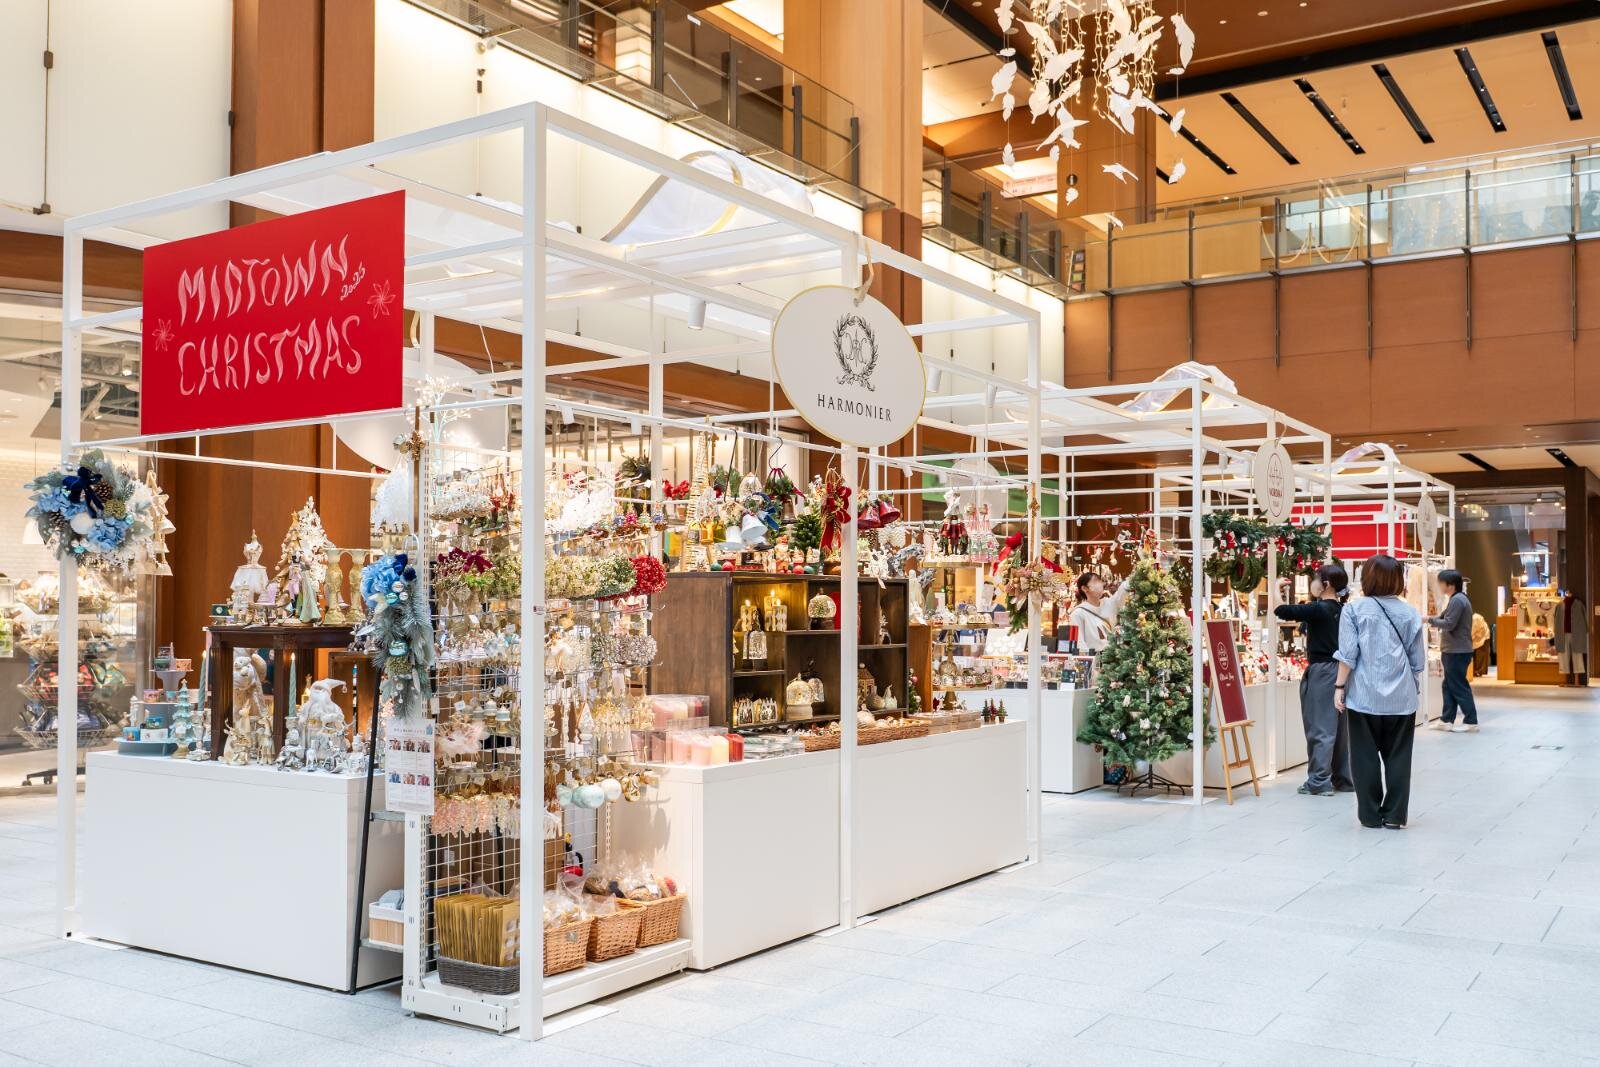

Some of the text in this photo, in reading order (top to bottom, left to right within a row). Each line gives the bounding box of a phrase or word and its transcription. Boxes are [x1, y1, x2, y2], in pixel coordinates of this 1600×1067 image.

[177, 233, 349, 327] MIDTOWN
[340, 260, 366, 301] 2025
[177, 314, 362, 396] CHRISTMAS
[817, 393, 892, 422] HARMONIER
